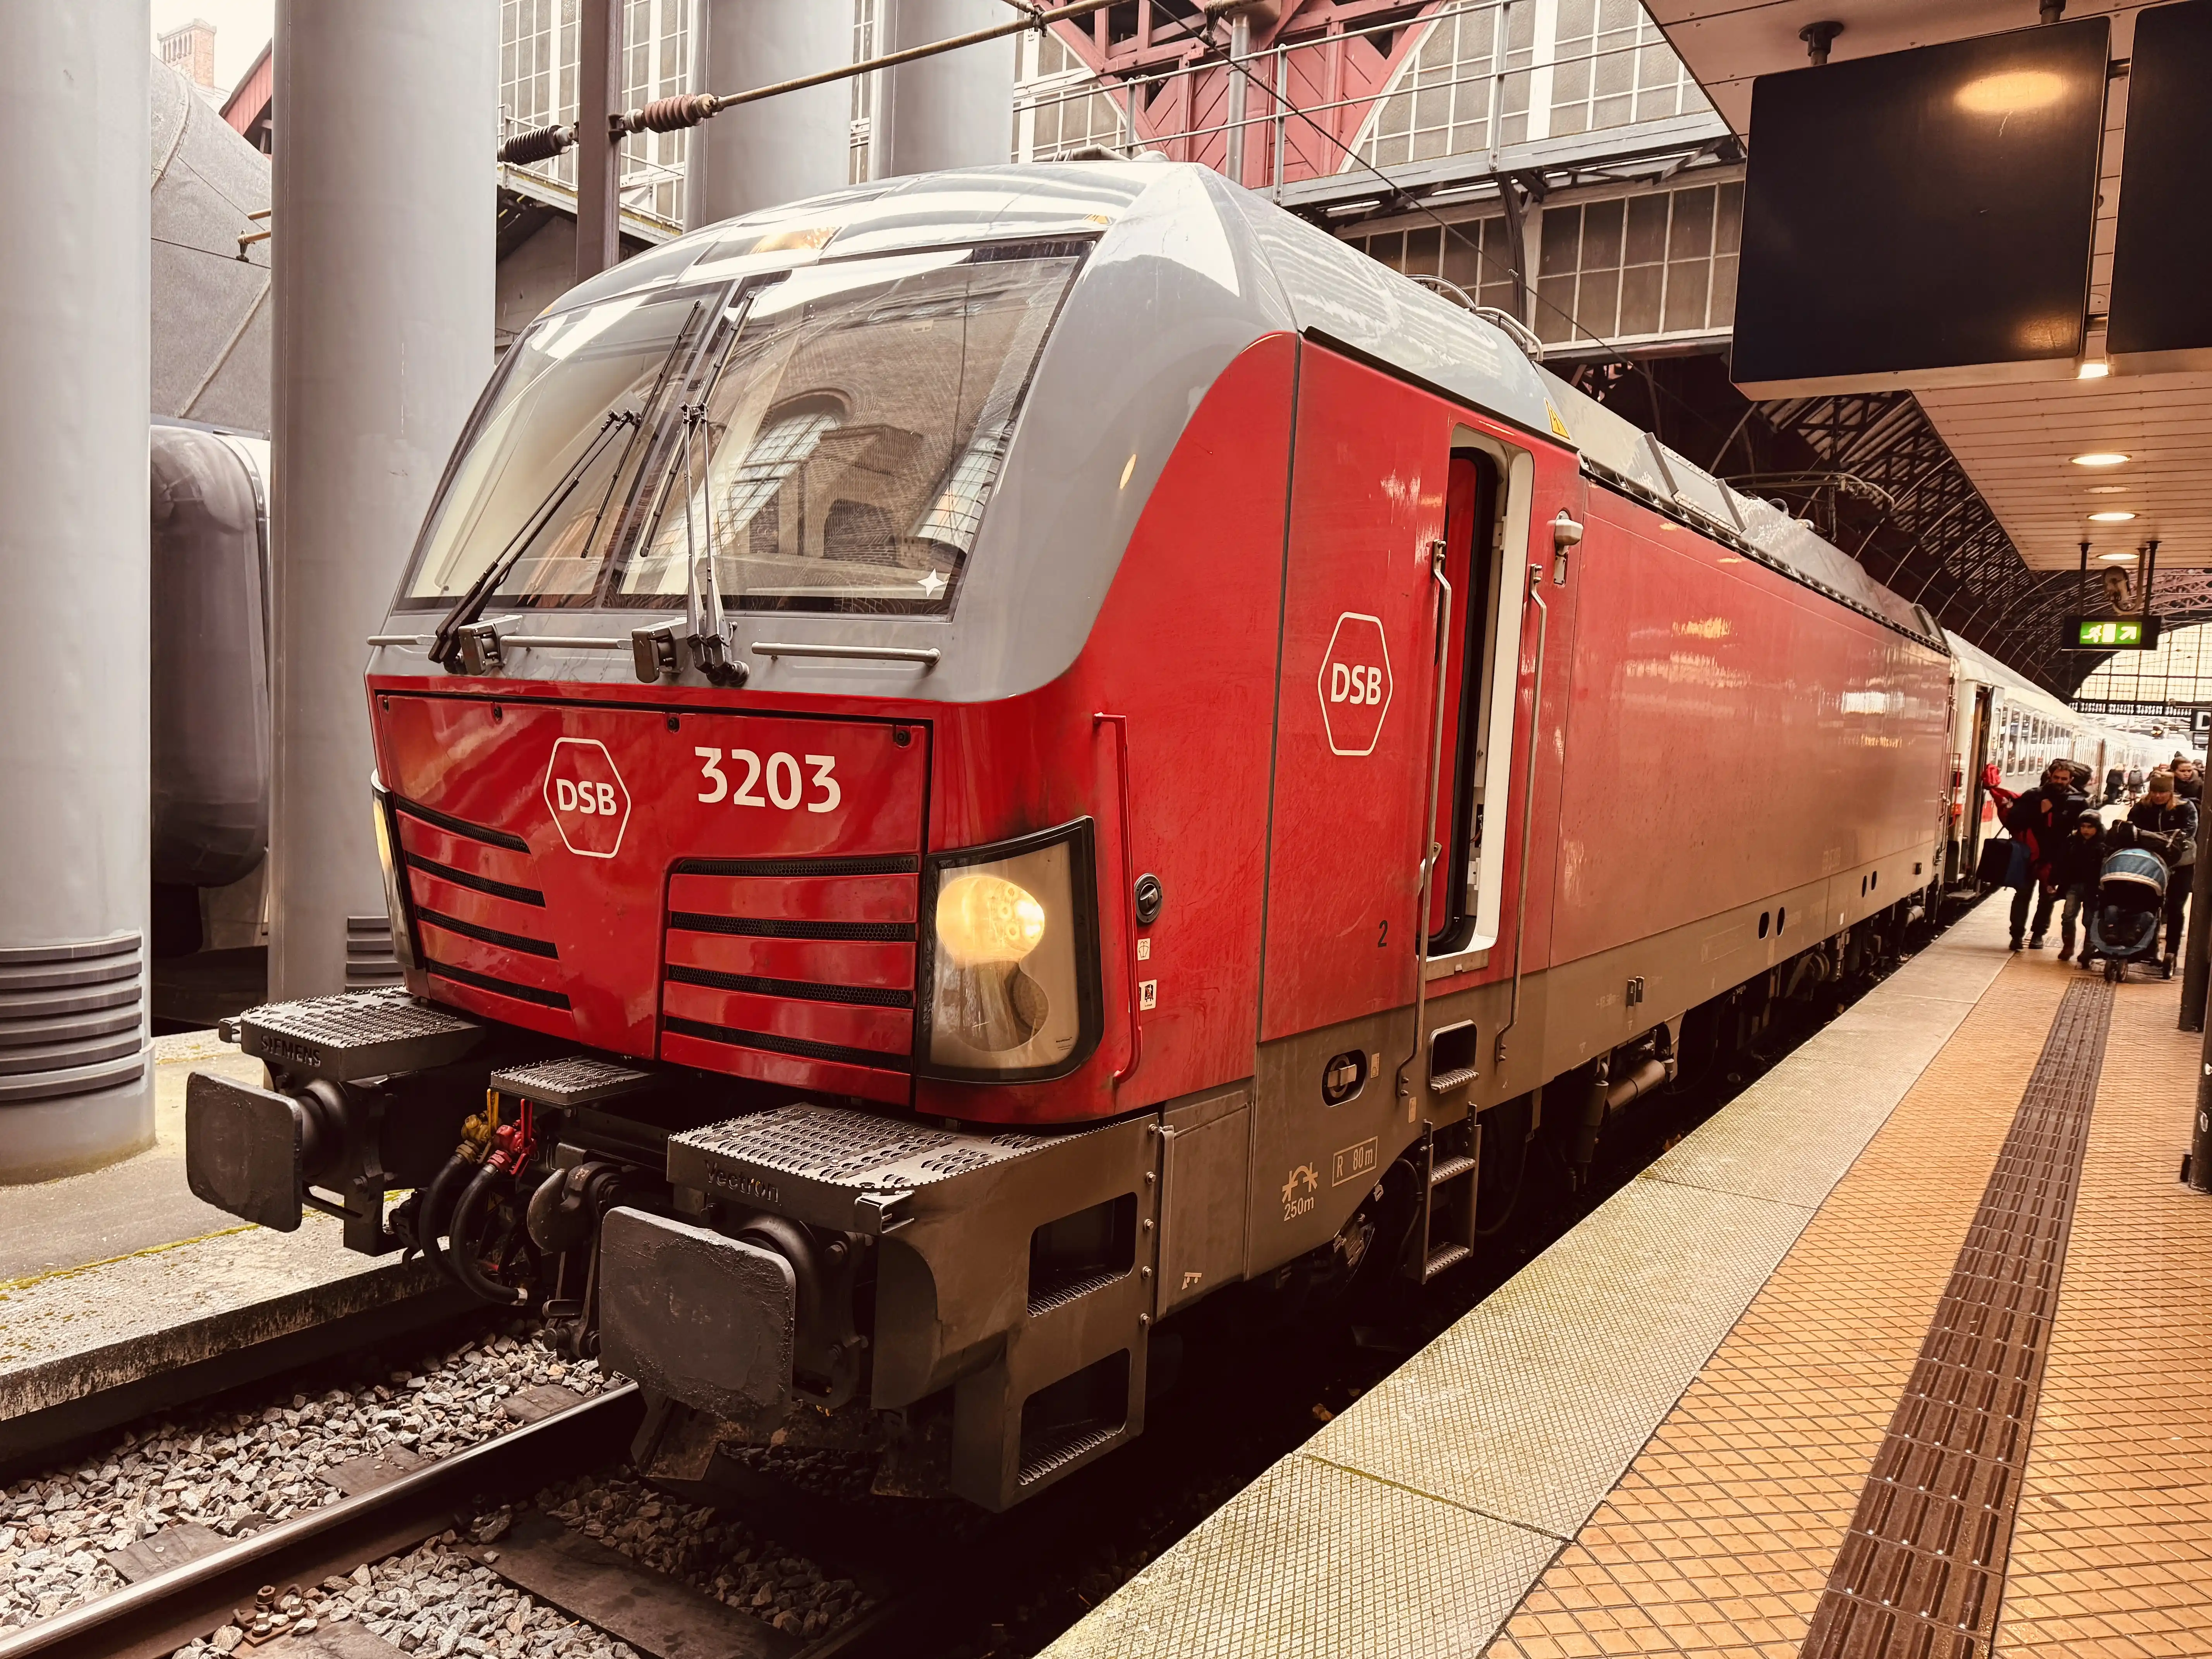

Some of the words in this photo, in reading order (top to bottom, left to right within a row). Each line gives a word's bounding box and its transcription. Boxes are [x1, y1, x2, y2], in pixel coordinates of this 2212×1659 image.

[1331, 663, 1381, 705] DSB
[556, 778, 617, 816] DSB
[695, 747, 841, 813] 3203
[1378, 920, 1388, 948] 2
[261, 1035, 321, 1068] SIEMENS
[1337, 1156, 1343, 1178] R
[1353, 1147, 1364, 1171] 80
[704, 1160, 778, 1202] Vectron
[1284, 1197, 1314, 1221] 250m
